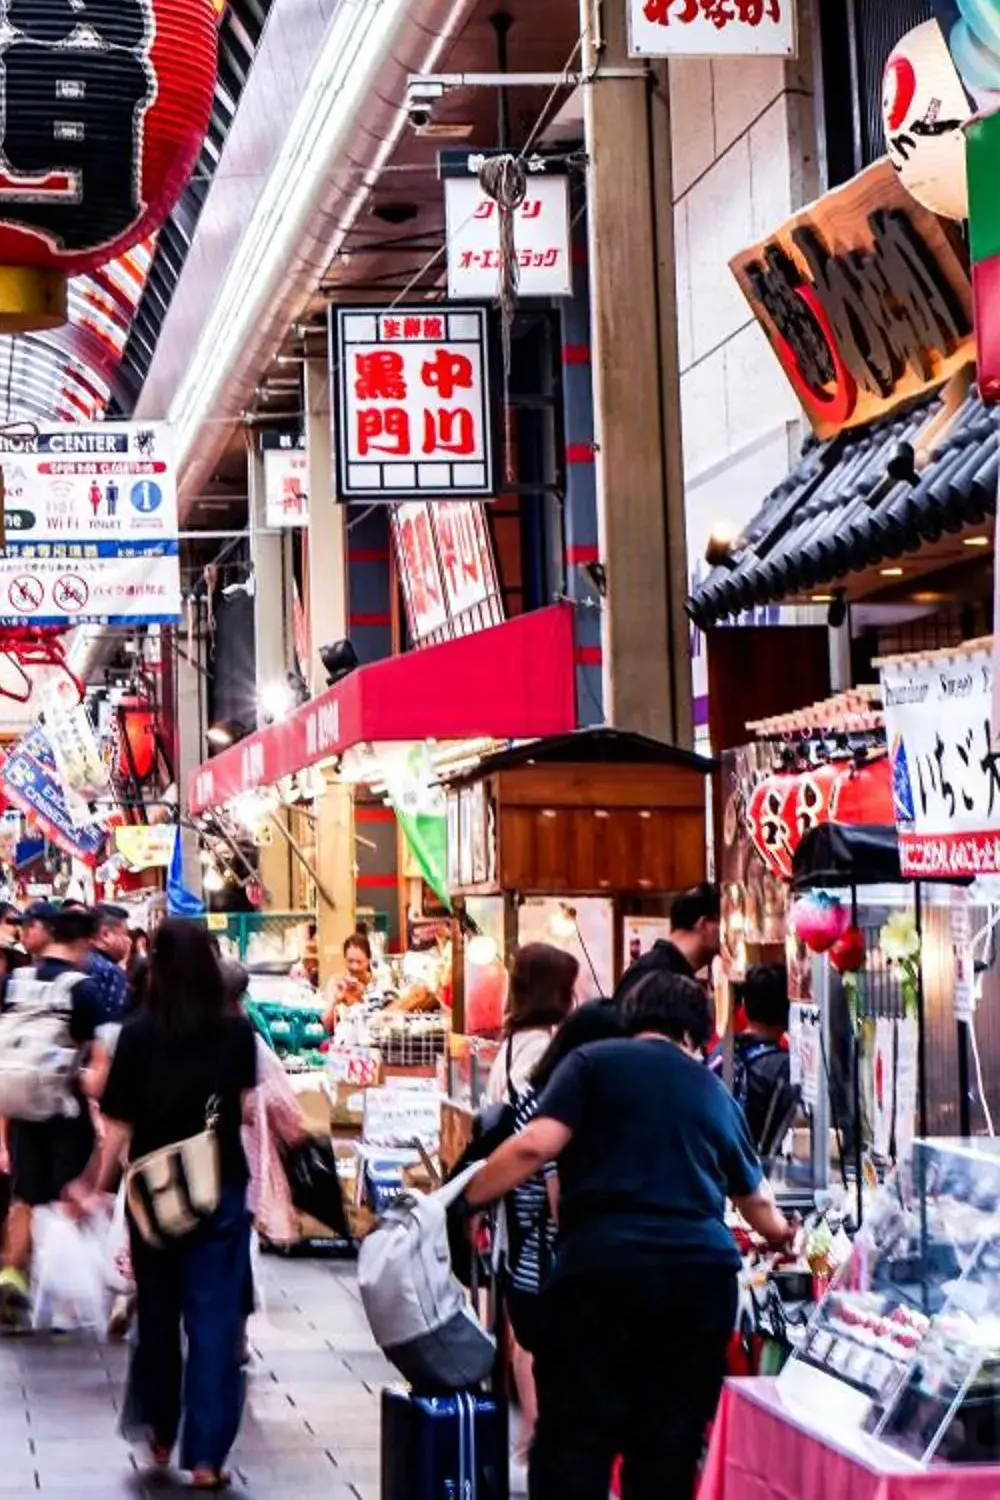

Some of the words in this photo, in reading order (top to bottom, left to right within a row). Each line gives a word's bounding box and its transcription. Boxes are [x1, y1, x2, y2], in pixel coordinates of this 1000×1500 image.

[472, 200, 542, 219] クリ
[354, 350, 411, 457] 黒門
[420, 348, 476, 456] 中川
[49, 433, 118, 452] CENTER
